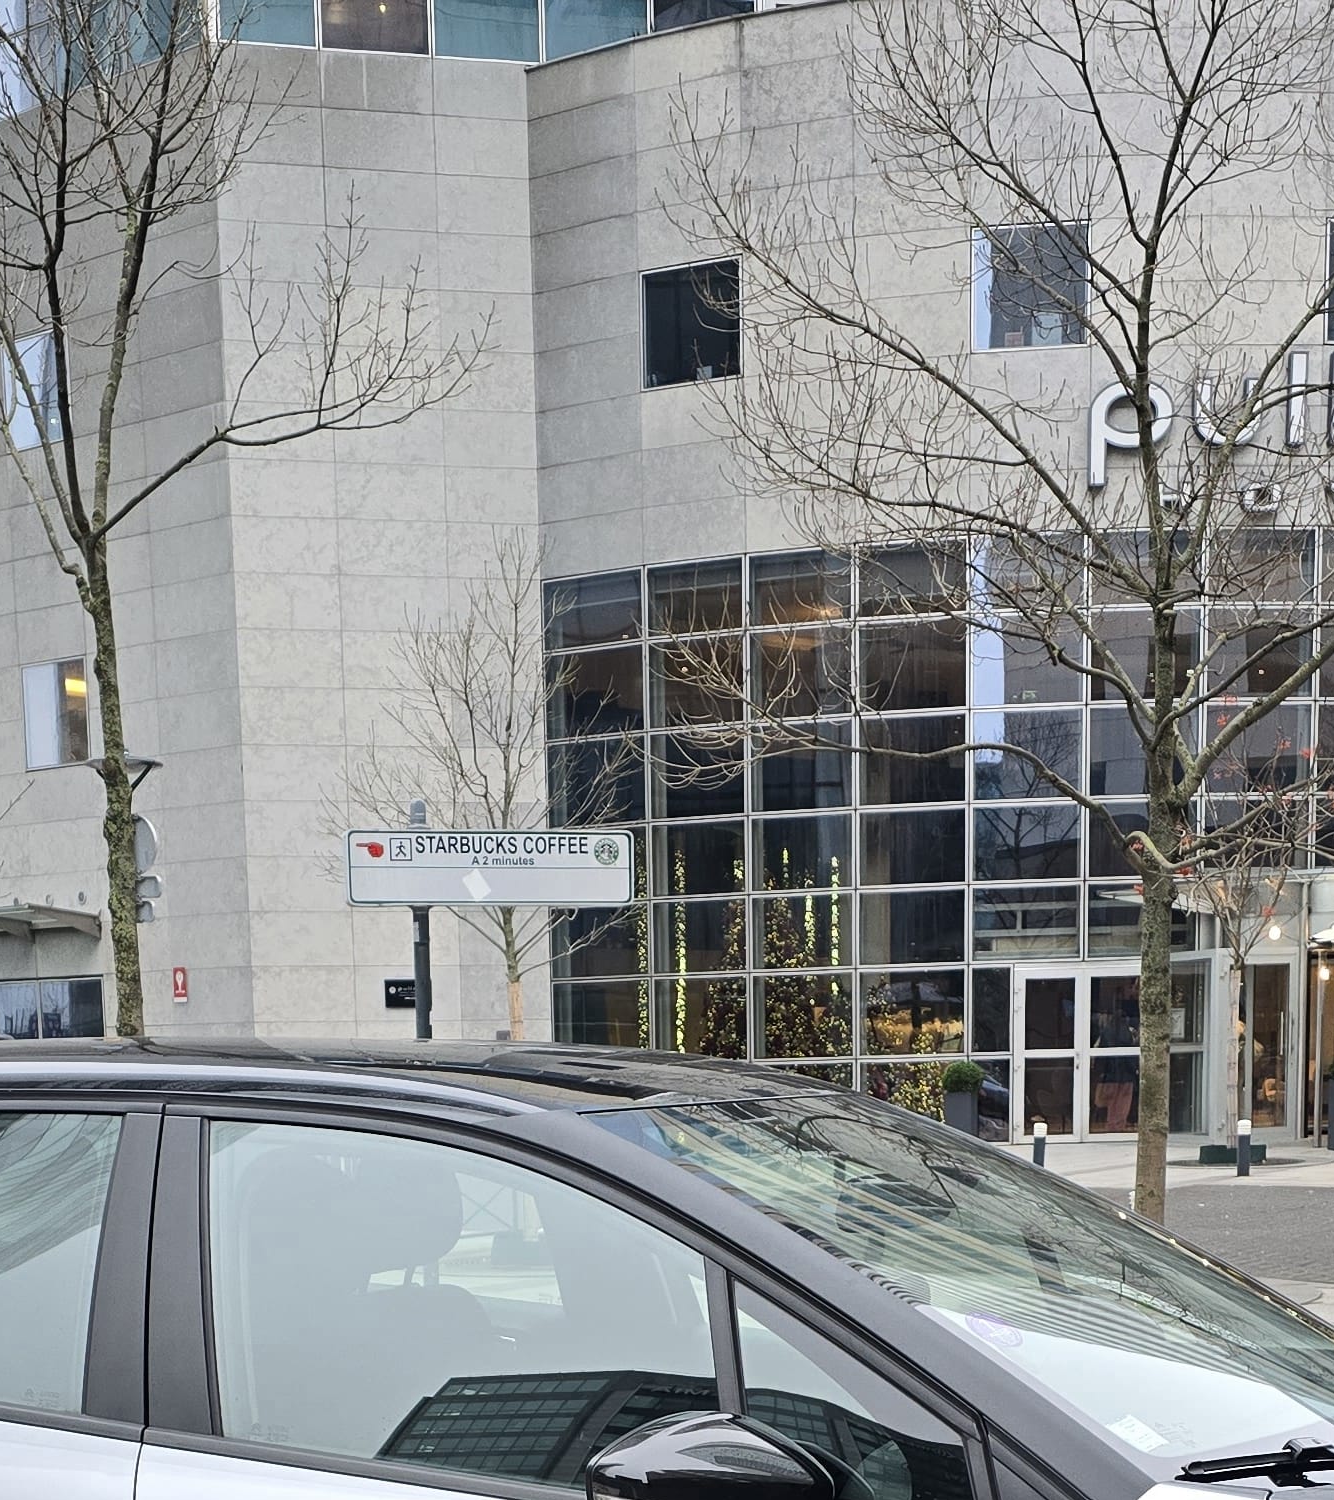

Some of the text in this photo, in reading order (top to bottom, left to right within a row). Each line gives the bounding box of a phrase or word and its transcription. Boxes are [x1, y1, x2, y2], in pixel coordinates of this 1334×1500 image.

[415, 836, 518, 854] STARBUCKS
[526, 836, 589, 854] COFFEE
[471, 856, 535, 866] A 2 minutes
